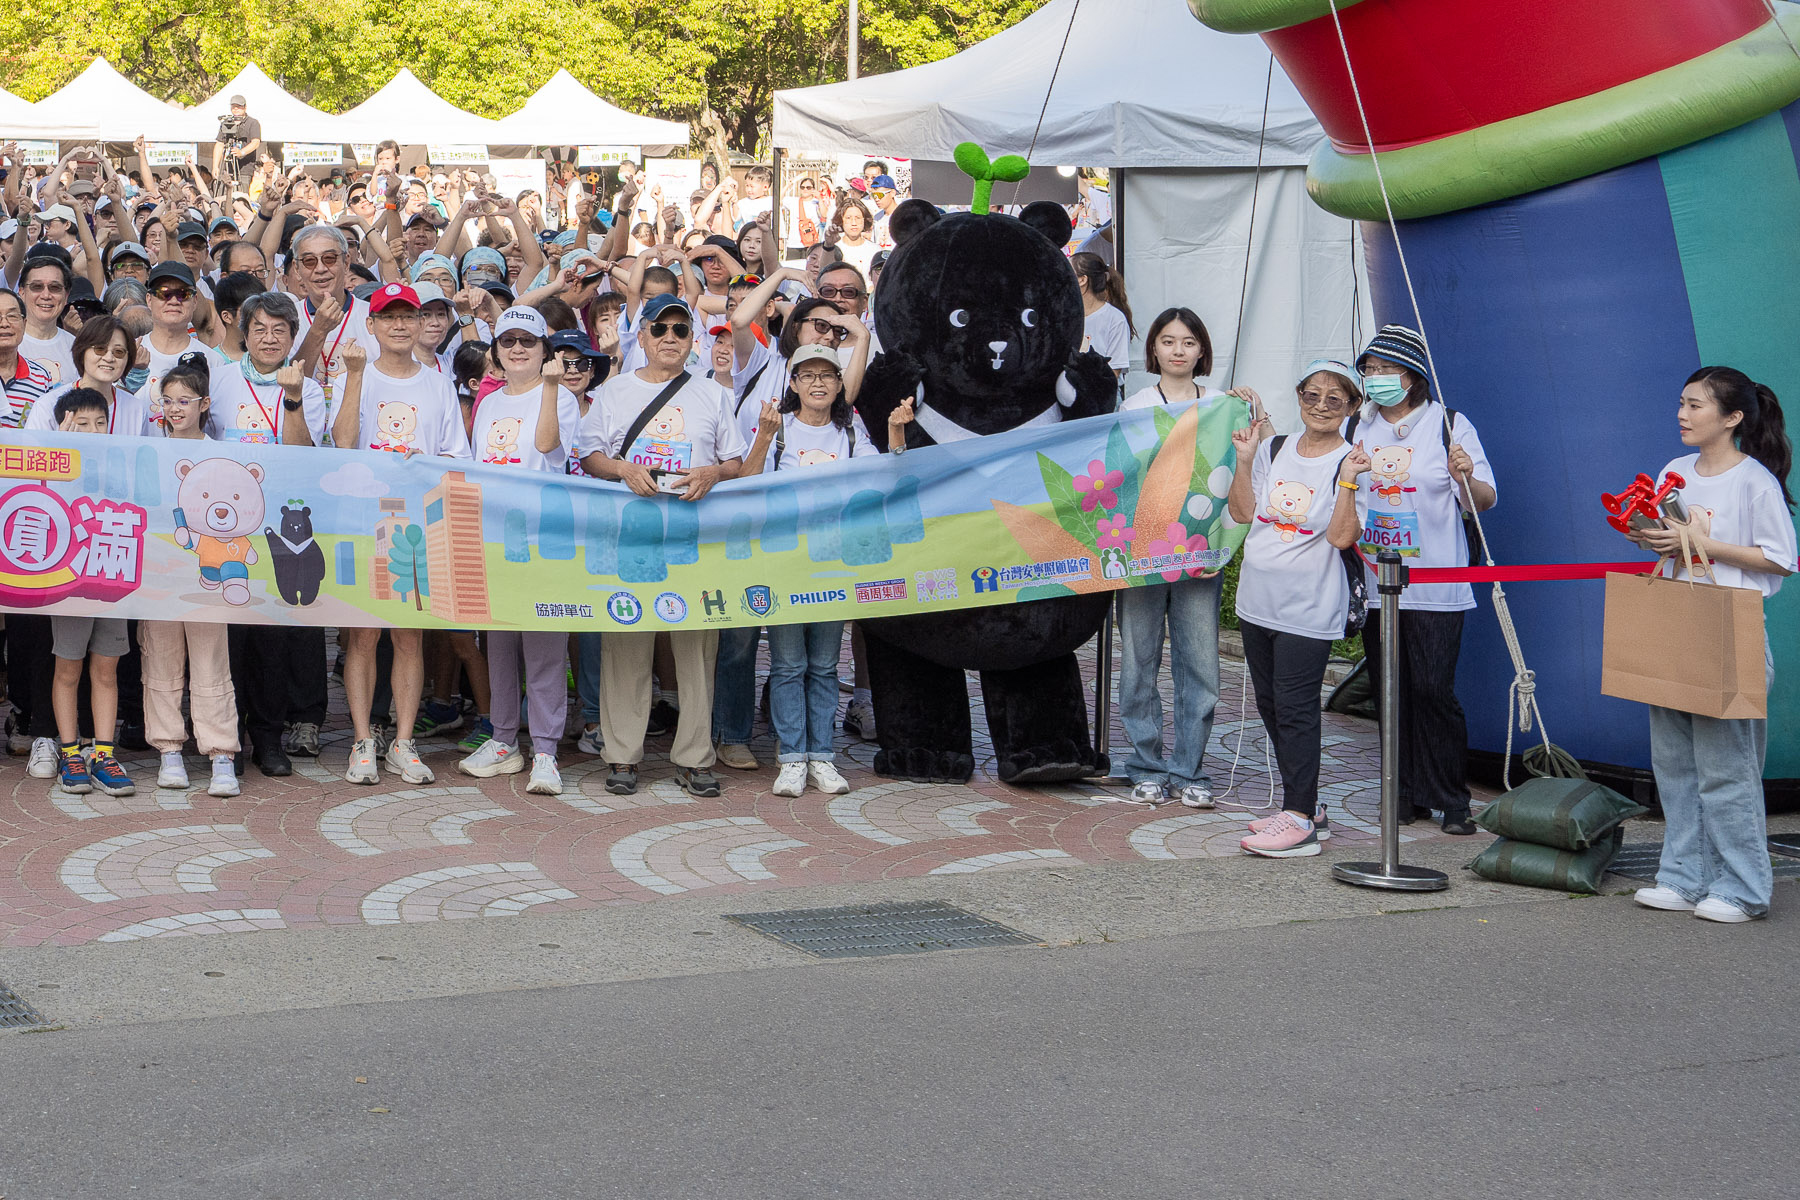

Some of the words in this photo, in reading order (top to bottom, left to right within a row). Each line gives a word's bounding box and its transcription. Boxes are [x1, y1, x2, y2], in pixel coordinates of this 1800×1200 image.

[510, 310, 535, 321] Penn
[1363, 527, 1412, 546] 00641
[999, 557, 1090, 582] 台灣安寧照顧協會
[857, 584, 906, 601] 商周集團
[1001, 582, 1023, 590] Taiwan
[1024, 579, 1049, 588] Hospice
[789, 589, 847, 605] PHILIPS
[535, 601, 594, 619] 協辦單位
